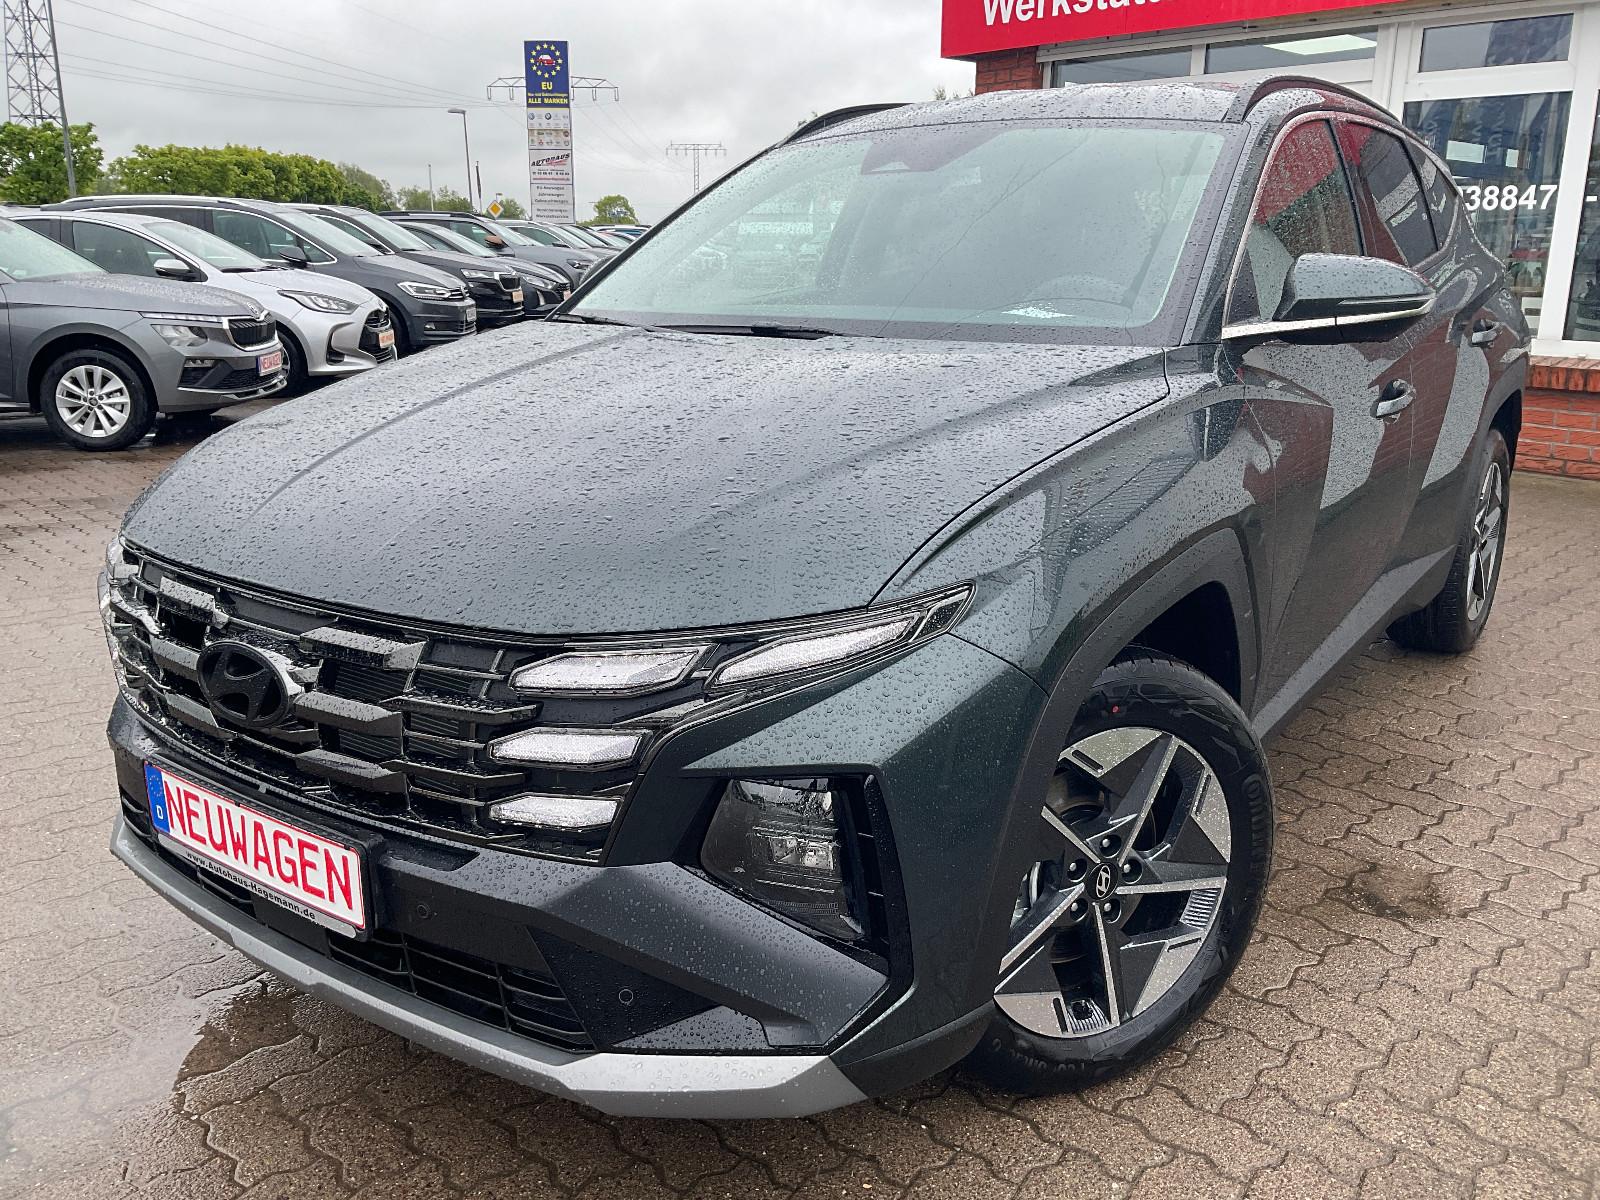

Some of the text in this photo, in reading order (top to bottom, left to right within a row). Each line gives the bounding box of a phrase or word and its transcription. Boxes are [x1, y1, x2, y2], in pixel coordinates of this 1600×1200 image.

[541, 81, 553, 90] EU
[156, 779, 354, 910] D NEUWAGEN
[184, 850, 317, 921] www.Autohaus-Hagemann.de
